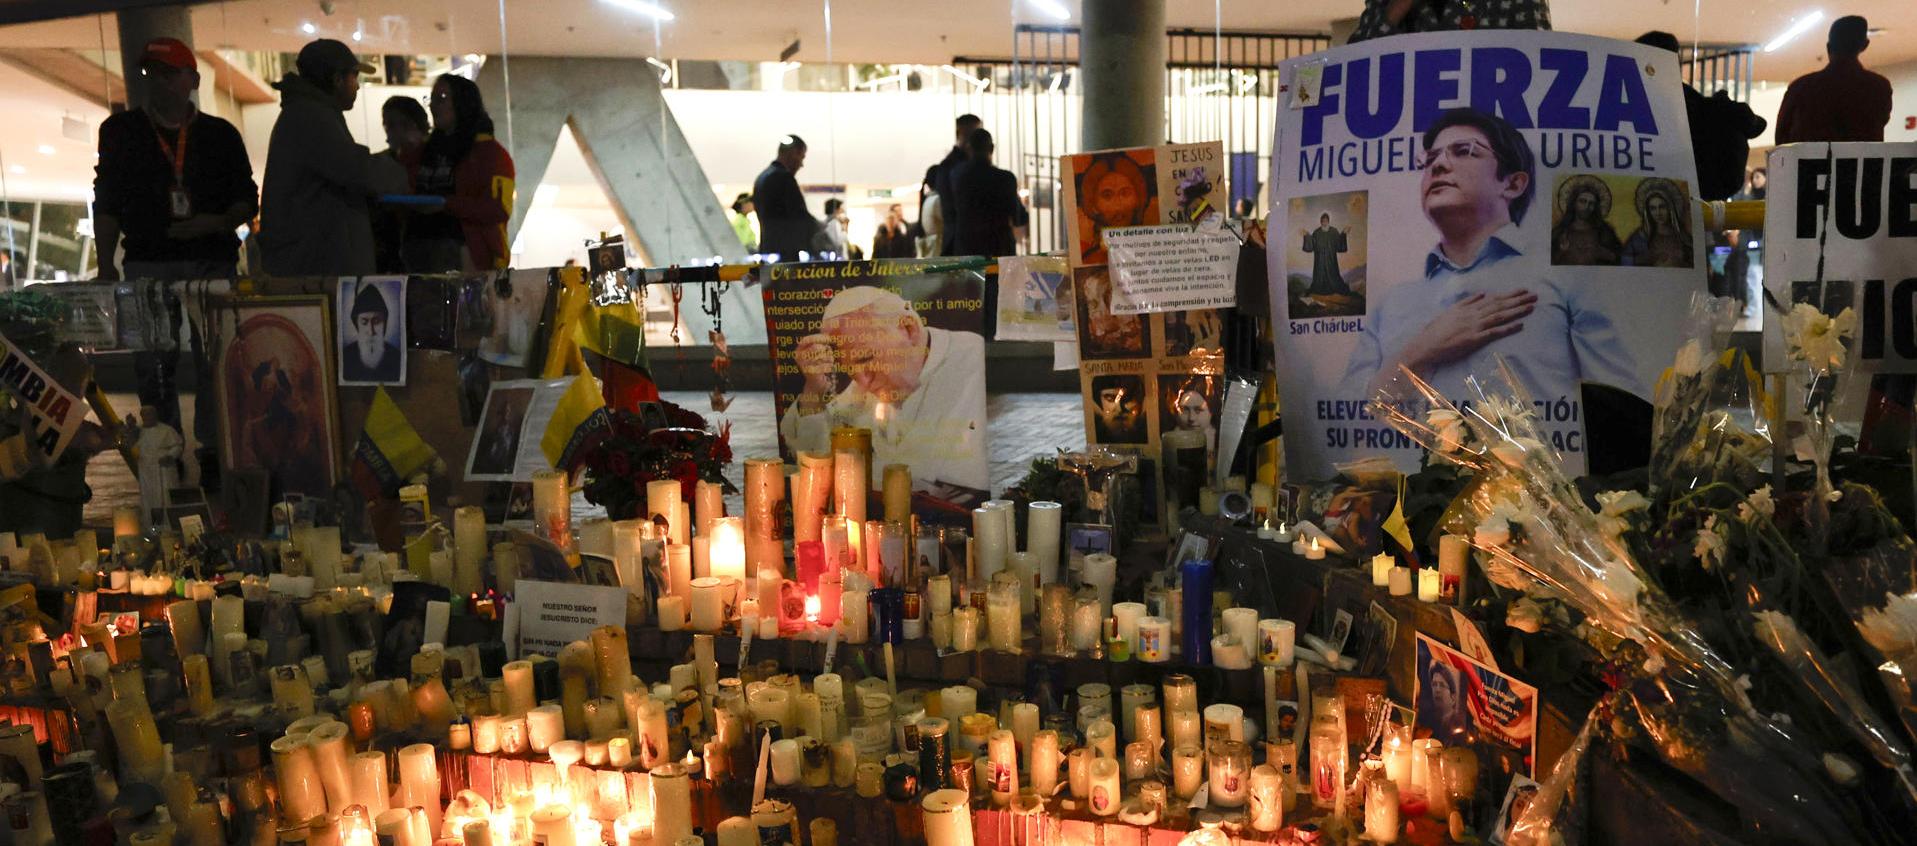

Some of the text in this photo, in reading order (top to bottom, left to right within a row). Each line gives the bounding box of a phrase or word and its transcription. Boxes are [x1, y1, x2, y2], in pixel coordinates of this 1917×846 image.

[1301, 47, 1659, 146] FUERZA
[1170, 148, 1213, 163] JESUS
[1299, 136, 1424, 183] MIGUEL
[1541, 132, 1656, 171] URIBE
[1123, 228, 1153, 237] detalle
[1156, 226, 1172, 234] con
[840, 261, 862, 279] de
[778, 288, 825, 302] corazón
[914, 300, 933, 312] por
[946, 298, 983, 312] amigo
[768, 319, 805, 330] uiado
[1289, 321, 1310, 336] San
[1327, 427, 1423, 450] SU PRONT
[542, 602, 598, 613] NUESTRO SEÑOR
